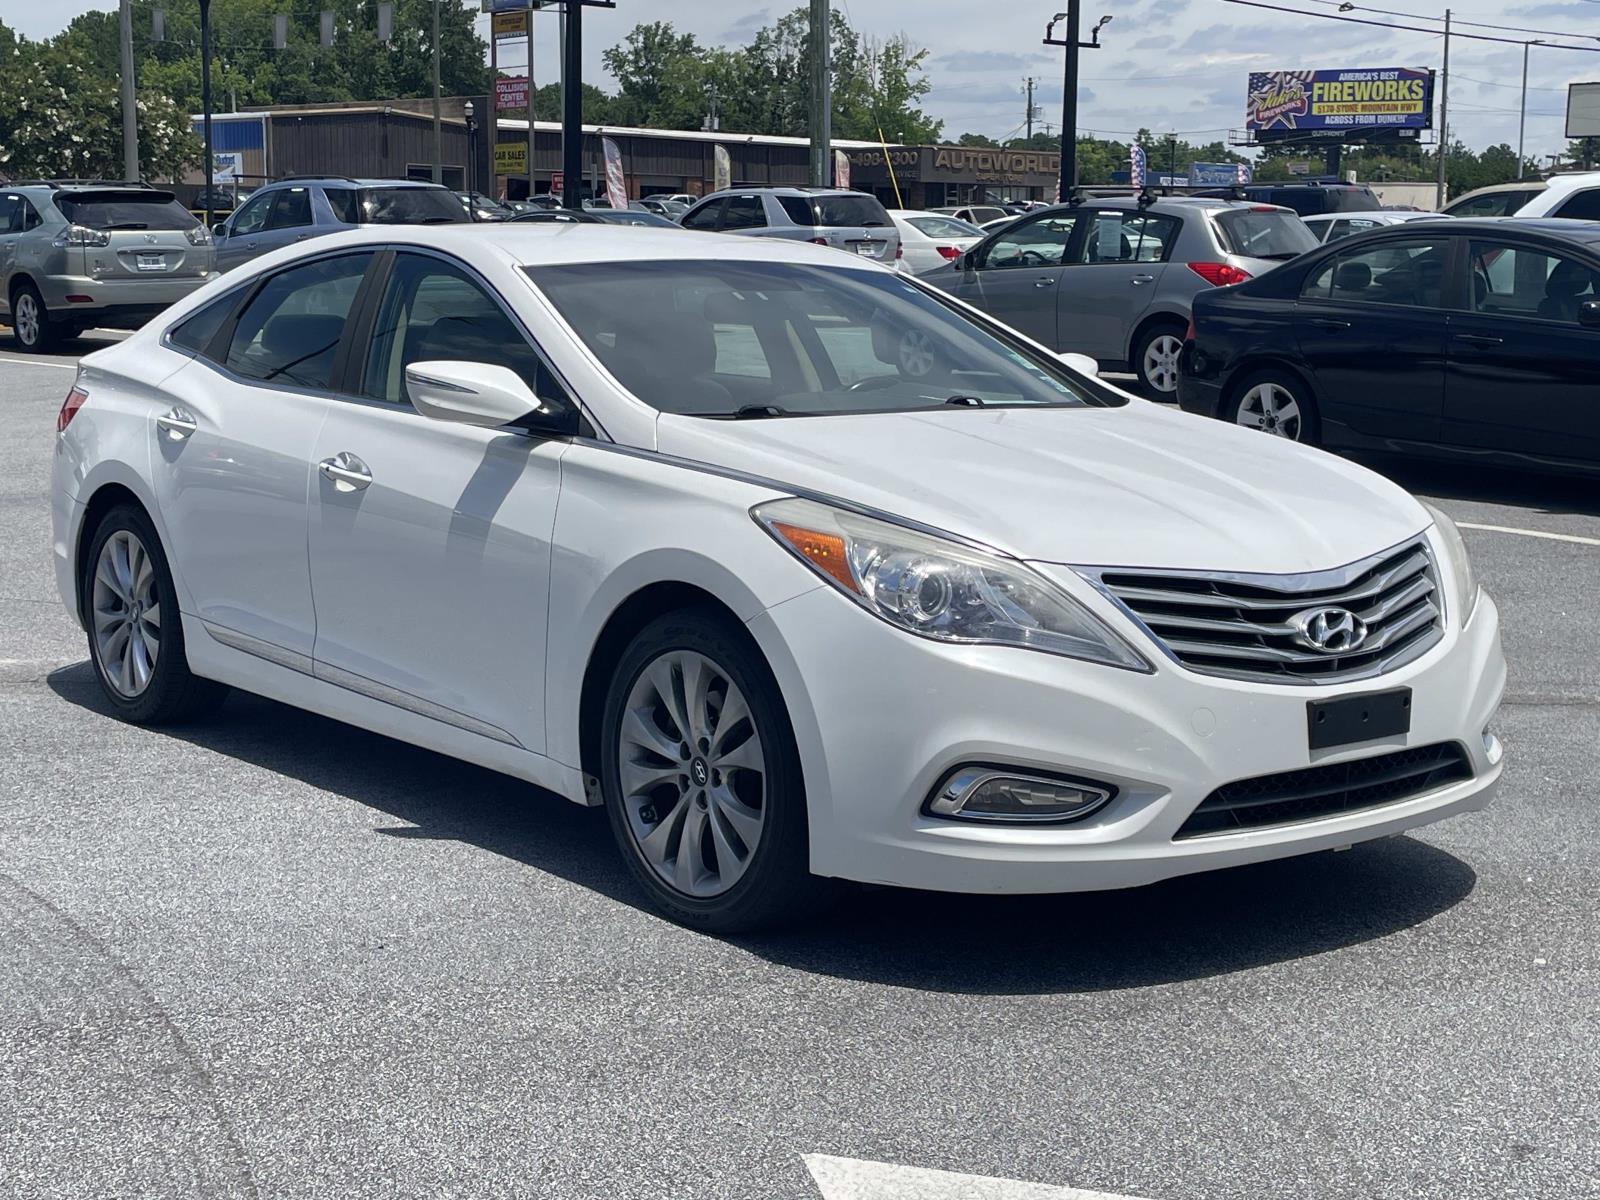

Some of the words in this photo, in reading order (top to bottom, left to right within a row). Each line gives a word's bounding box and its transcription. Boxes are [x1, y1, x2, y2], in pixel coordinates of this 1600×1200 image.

[1339, 72, 1378, 81] AMERICA'S
[1380, 71, 1399, 80] BEST
[496, 83, 528, 93] COLLISION
[1313, 80, 1424, 102] FIREWORKS
[500, 92, 525, 102] CENTER
[1259, 99, 1302, 120] FIREWORKS
[1336, 104, 1359, 113] STONE
[1361, 103, 1398, 112] MOUNTAIN
[1400, 103, 1418, 111] HWY
[1325, 116, 1354, 124] ACROSS
[1355, 115, 1376, 124] FROM
[495, 151, 506, 160] CAR
[507, 150, 526, 160] SALES
[935, 150, 1060, 173] AUTOWORLD
